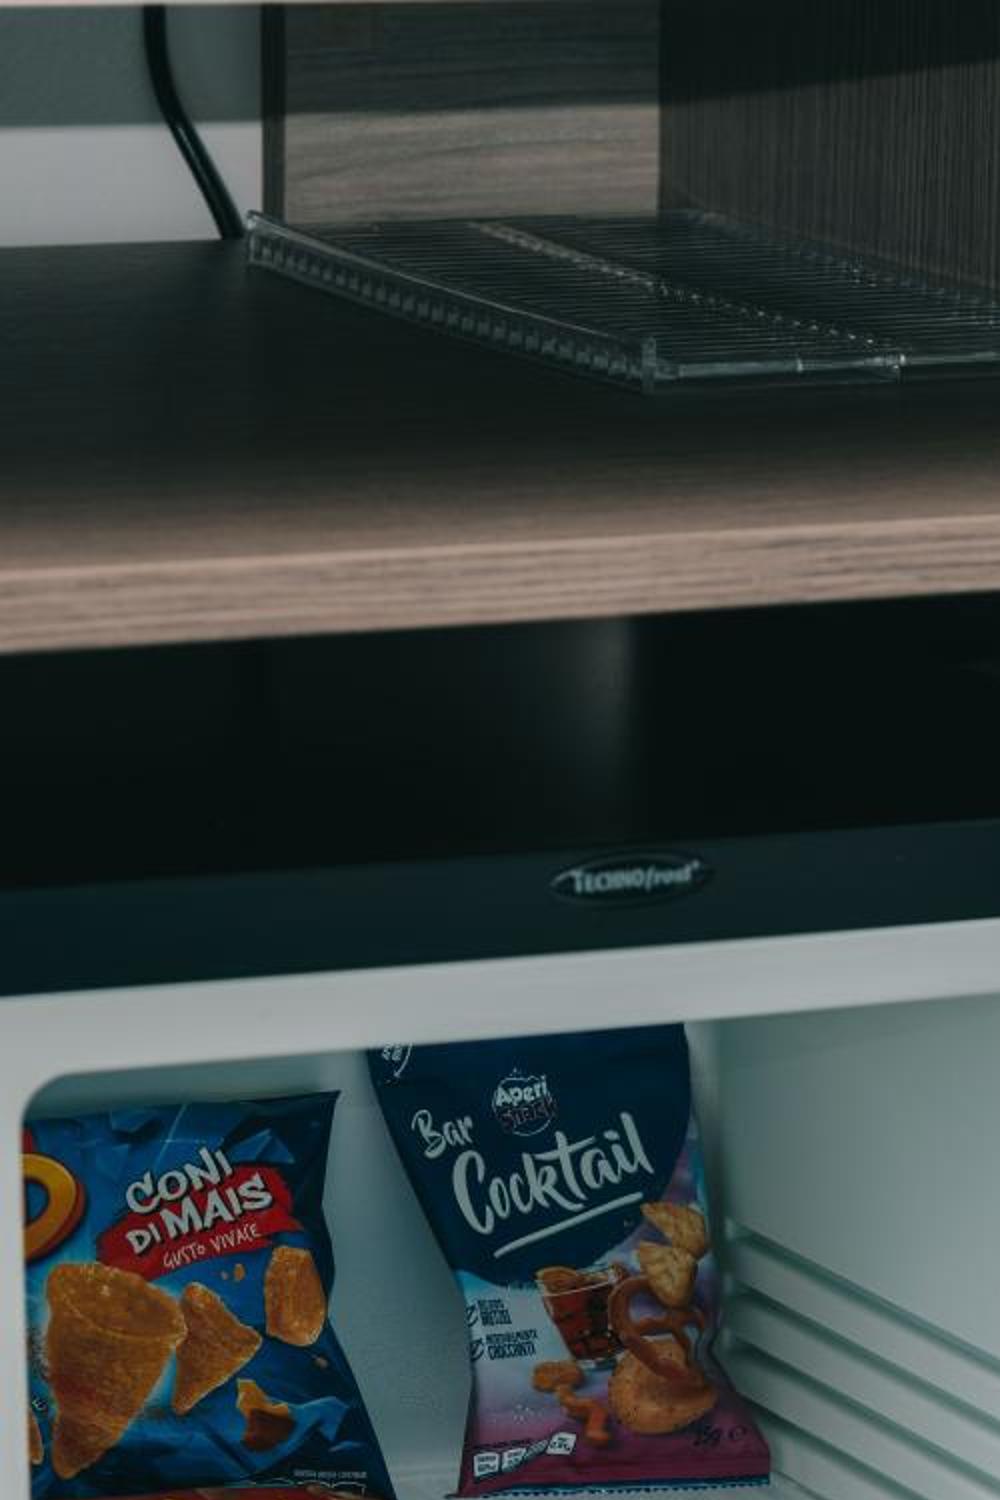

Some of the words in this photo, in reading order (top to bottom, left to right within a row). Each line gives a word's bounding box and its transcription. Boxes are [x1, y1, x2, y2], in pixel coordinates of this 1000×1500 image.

[495, 1074, 548, 1107] Aperi
[411, 1109, 475, 1160] Bar
[126, 1146, 234, 1214] CONI
[452, 1111, 655, 1235] Cocktail
[126, 1223, 162, 1254] DI
[160, 1172, 273, 1240] MAIS
[210, 1223, 262, 1252] VIVACE
